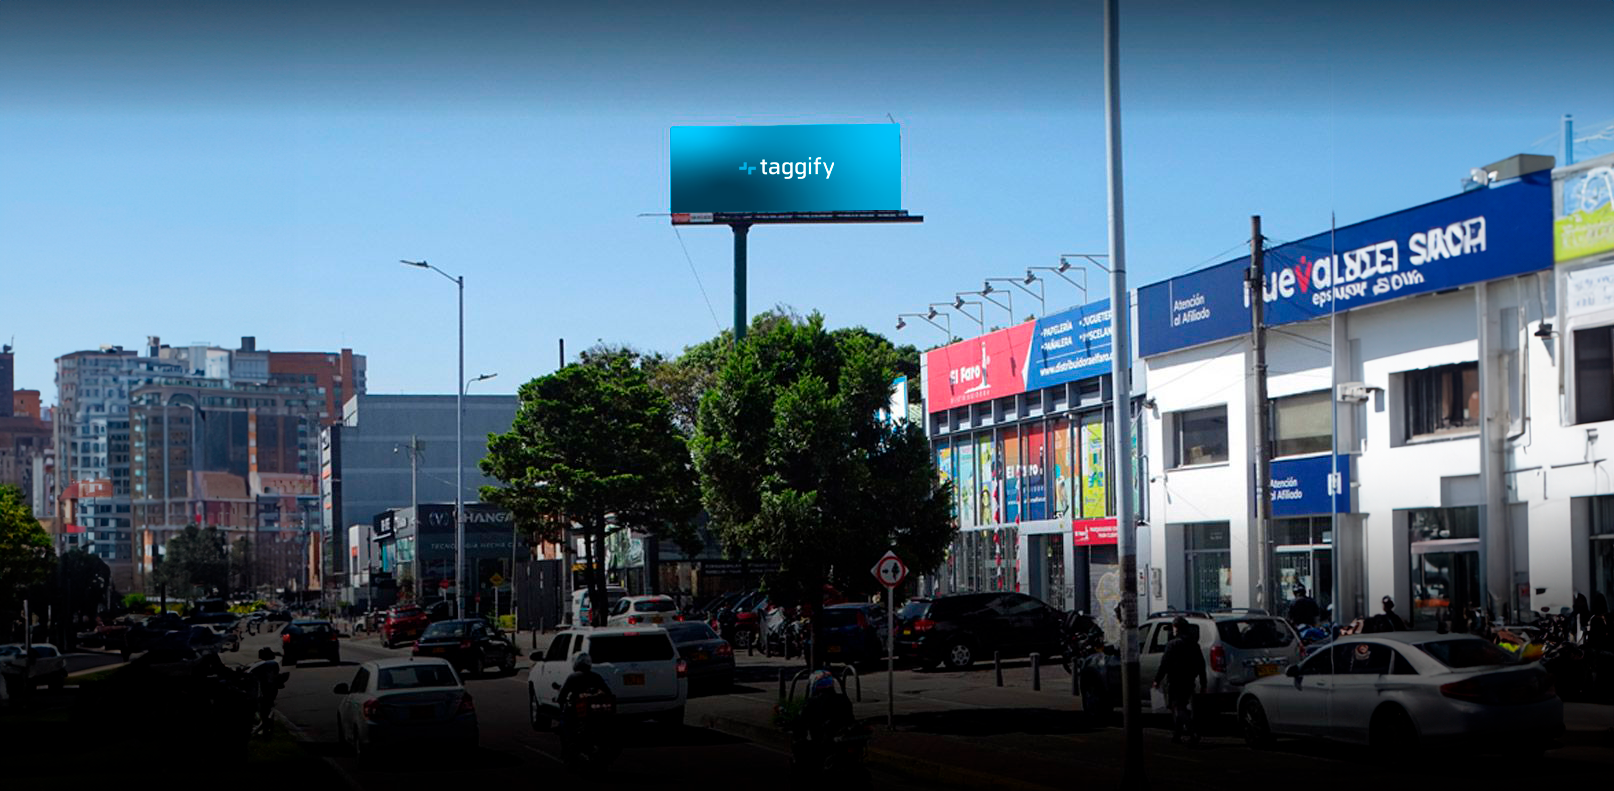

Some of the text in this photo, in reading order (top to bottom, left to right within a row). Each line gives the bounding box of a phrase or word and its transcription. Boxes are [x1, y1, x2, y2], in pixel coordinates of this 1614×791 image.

[760, 156, 835, 179] taggify
[1174, 292, 1205, 312] Atención
[1174, 307, 1210, 326] al Afiliado
[950, 365, 980, 384] El Faro
[1270, 477, 1297, 487] Atención
[1277, 489, 1303, 500] Afiliado
[452, 511, 514, 523] HANGA
